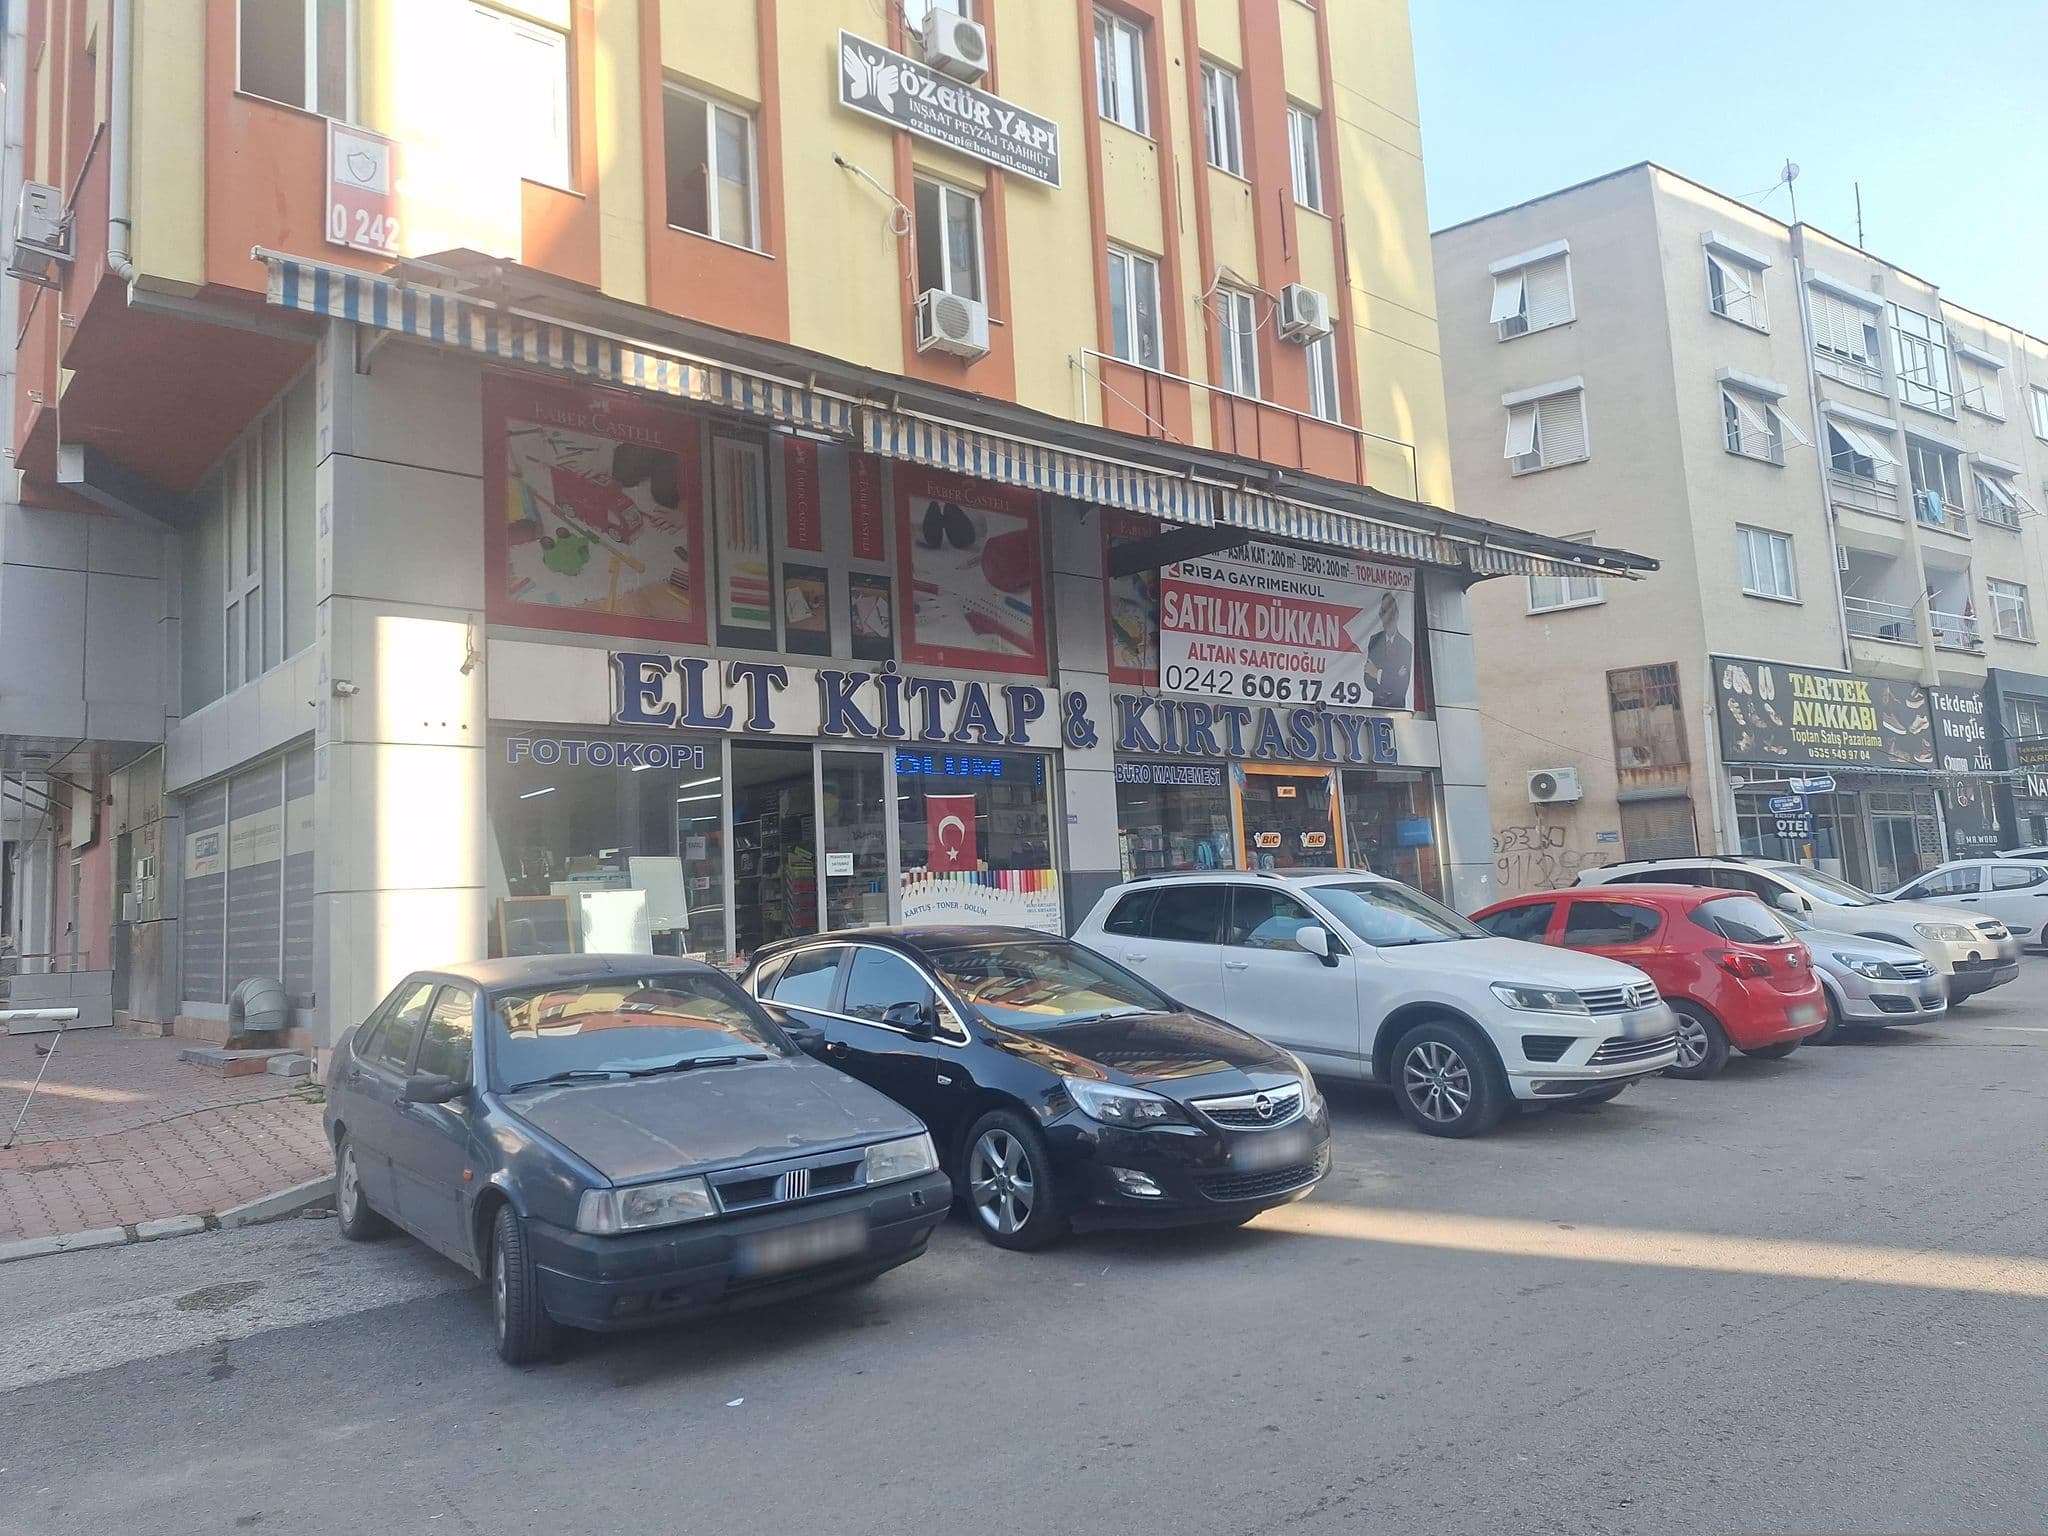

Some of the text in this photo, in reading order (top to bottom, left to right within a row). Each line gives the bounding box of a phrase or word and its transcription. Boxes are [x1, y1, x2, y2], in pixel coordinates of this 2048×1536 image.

[900, 63, 1057, 156] ÖZGÜR YAPI
[909, 100, 1051, 168] İNŞAAT PEYZAJ TAAHHÜT
[909, 117, 1049, 180] ozguryapi@hotmail.com.tr
[332, 203, 401, 252] 0 242
[1250, 546, 1266, 565] KAT
[1271, 550, 1286, 569] 200
[1302, 555, 1322, 575] DEPO
[1326, 559, 1340, 578] 200
[1356, 565, 1388, 585] TOPLAM
[1228, 572, 1325, 598] GAYRIMENKUL
[1163, 590, 1340, 649] SATILIK DÜKKAN
[1188, 641, 1326, 674] ALTAN SAATCIOĞLU
[1165, 664, 1362, 704] 0242 606 17 49
[1788, 672, 1872, 705] TARTEK
[614, 651, 1399, 765] ELT KİTAP & KIRTASİYE
[1792, 700, 1878, 731] AYAKKABI
[1931, 691, 1984, 715] Tekdemir
[1790, 727, 1883, 748] Toplan Satış Pazarlama
[1943, 717, 1986, 743] Nargile
[1860, 750, 1871, 760] 04
[1116, 763, 1150, 784] BÜRO
[1776, 820, 1809, 831] OTEL
[904, 903, 931, 919] KARTUŞ
[936, 901, 959, 910] TONER
[963, 903, 988, 917] DOLUM
